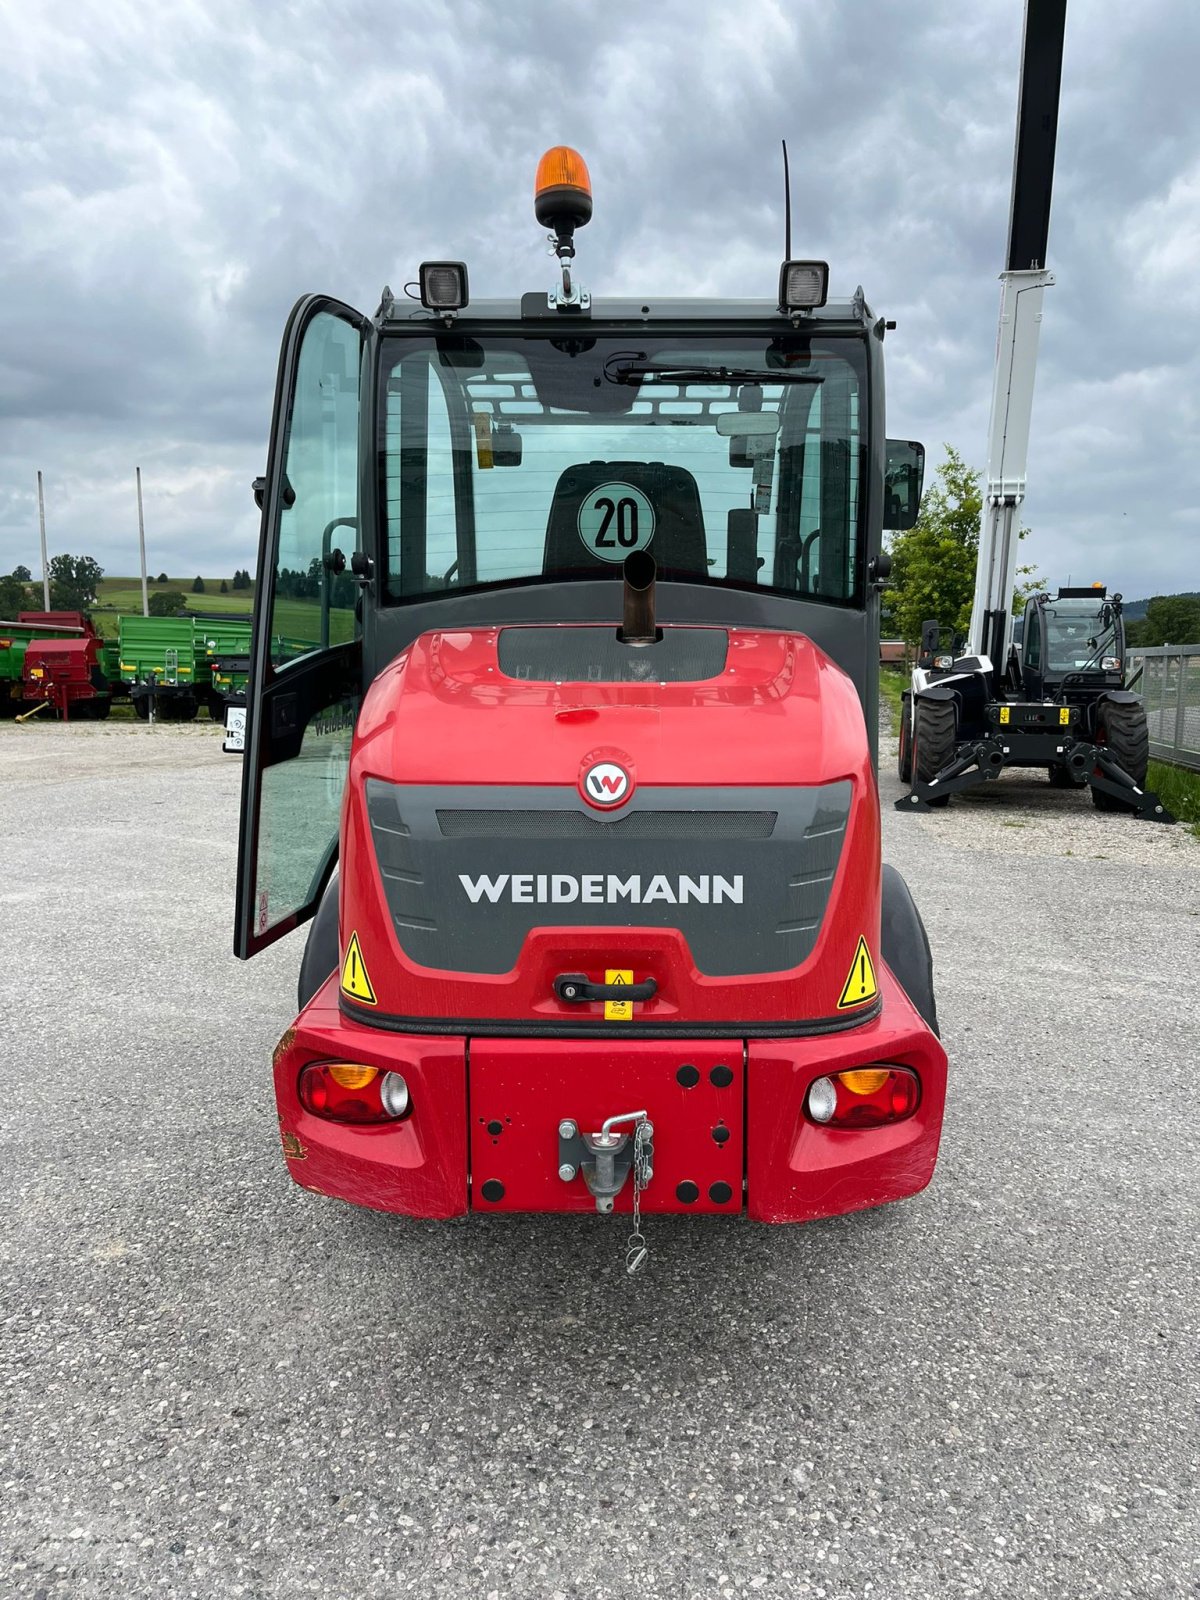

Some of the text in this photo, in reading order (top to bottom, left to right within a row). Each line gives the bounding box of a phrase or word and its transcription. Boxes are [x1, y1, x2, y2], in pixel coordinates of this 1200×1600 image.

[594, 497, 639, 548] 20
[589, 775, 624, 794] W
[458, 874, 744, 904] WEIDEMANN
